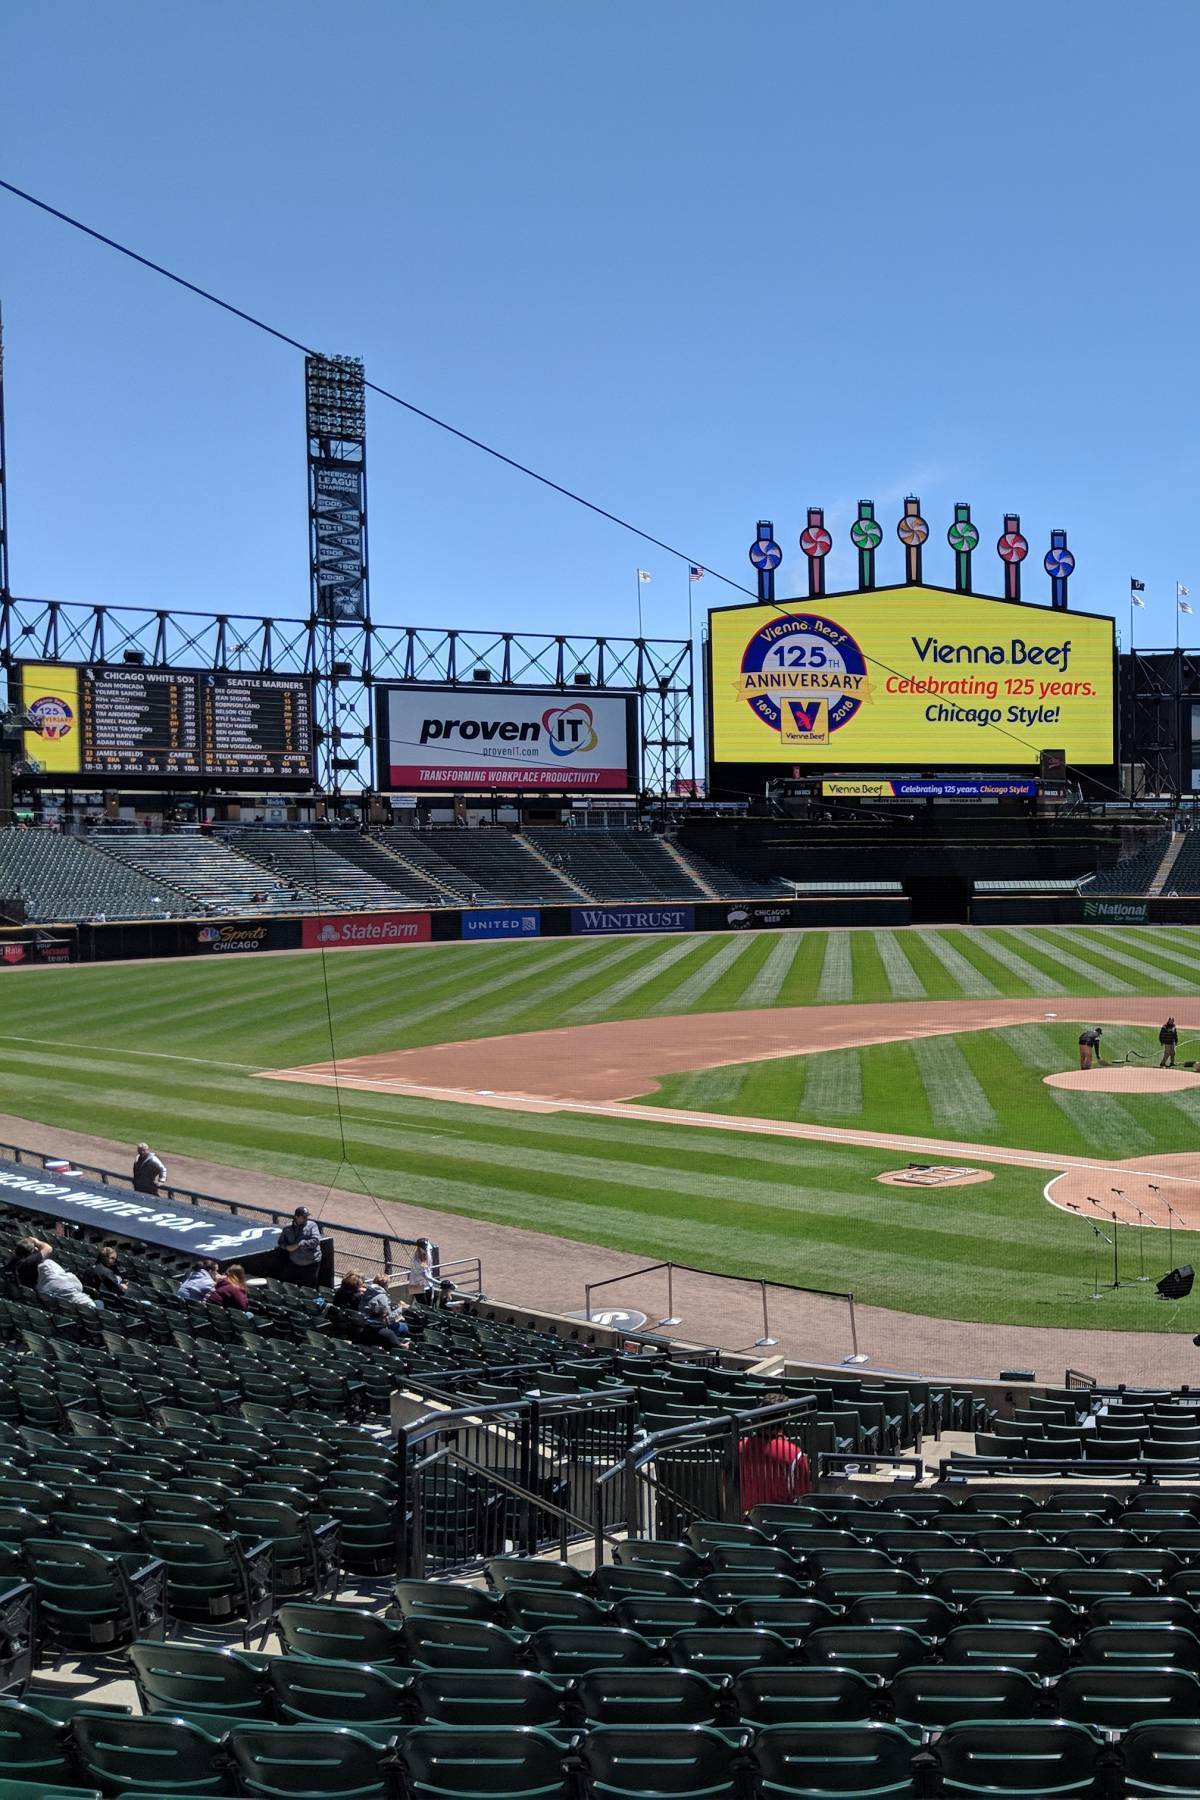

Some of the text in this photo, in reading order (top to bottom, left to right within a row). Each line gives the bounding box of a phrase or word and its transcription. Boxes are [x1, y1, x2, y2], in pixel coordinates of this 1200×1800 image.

[318, 470, 358, 480] AMERICAN
[319, 476, 358, 488] LEAGUE
[318, 484, 358, 494] CHAMPIONS
[760, 620, 848, 646] Vienna Beef
[912, 636, 1072, 672] Vienna Beef
[104, 672, 195, 684] CHICAGO WHITE SOX
[227, 678, 304, 690] SEATTLE MARINERS
[744, 673, 864, 690] ANNIVERSARY
[114, 682, 144, 690] MONCADA
[226, 688, 250, 696] GORDON
[886, 676, 1096, 700] Celebrating 125 years.
[120, 690, 147, 698] SANCHEZ
[96, 702, 150, 712] NICKY DELMONICO
[756, 700, 777, 720] 1893
[832, 700, 854, 722] 2018
[925, 704, 1060, 727] Chicago Style!
[420, 718, 583, 744] proven IT
[482, 746, 540, 758] provenIT.com
[420, 770, 600, 784] TRANSFORMING WORKPLACE PRODUCTIVITY
[829, 784, 883, 796] Vienna Beef
[900, 785, 943, 794] Celebrating
[956, 786, 979, 795] years.
[980, 786, 1008, 795] Chicago
[1009, 786, 1030, 795] Style!
[754, 908, 791, 916] CHICAGO'S
[1098, 904, 1147, 916] National
[468, 920, 520, 930] UNITED
[581, 910, 686, 928] WINTRUST
[219, 926, 268, 942] Sports
[212, 940, 259, 950] CHICAGO
[0, 1170, 216, 1232] ICAGO WHITE SOX
